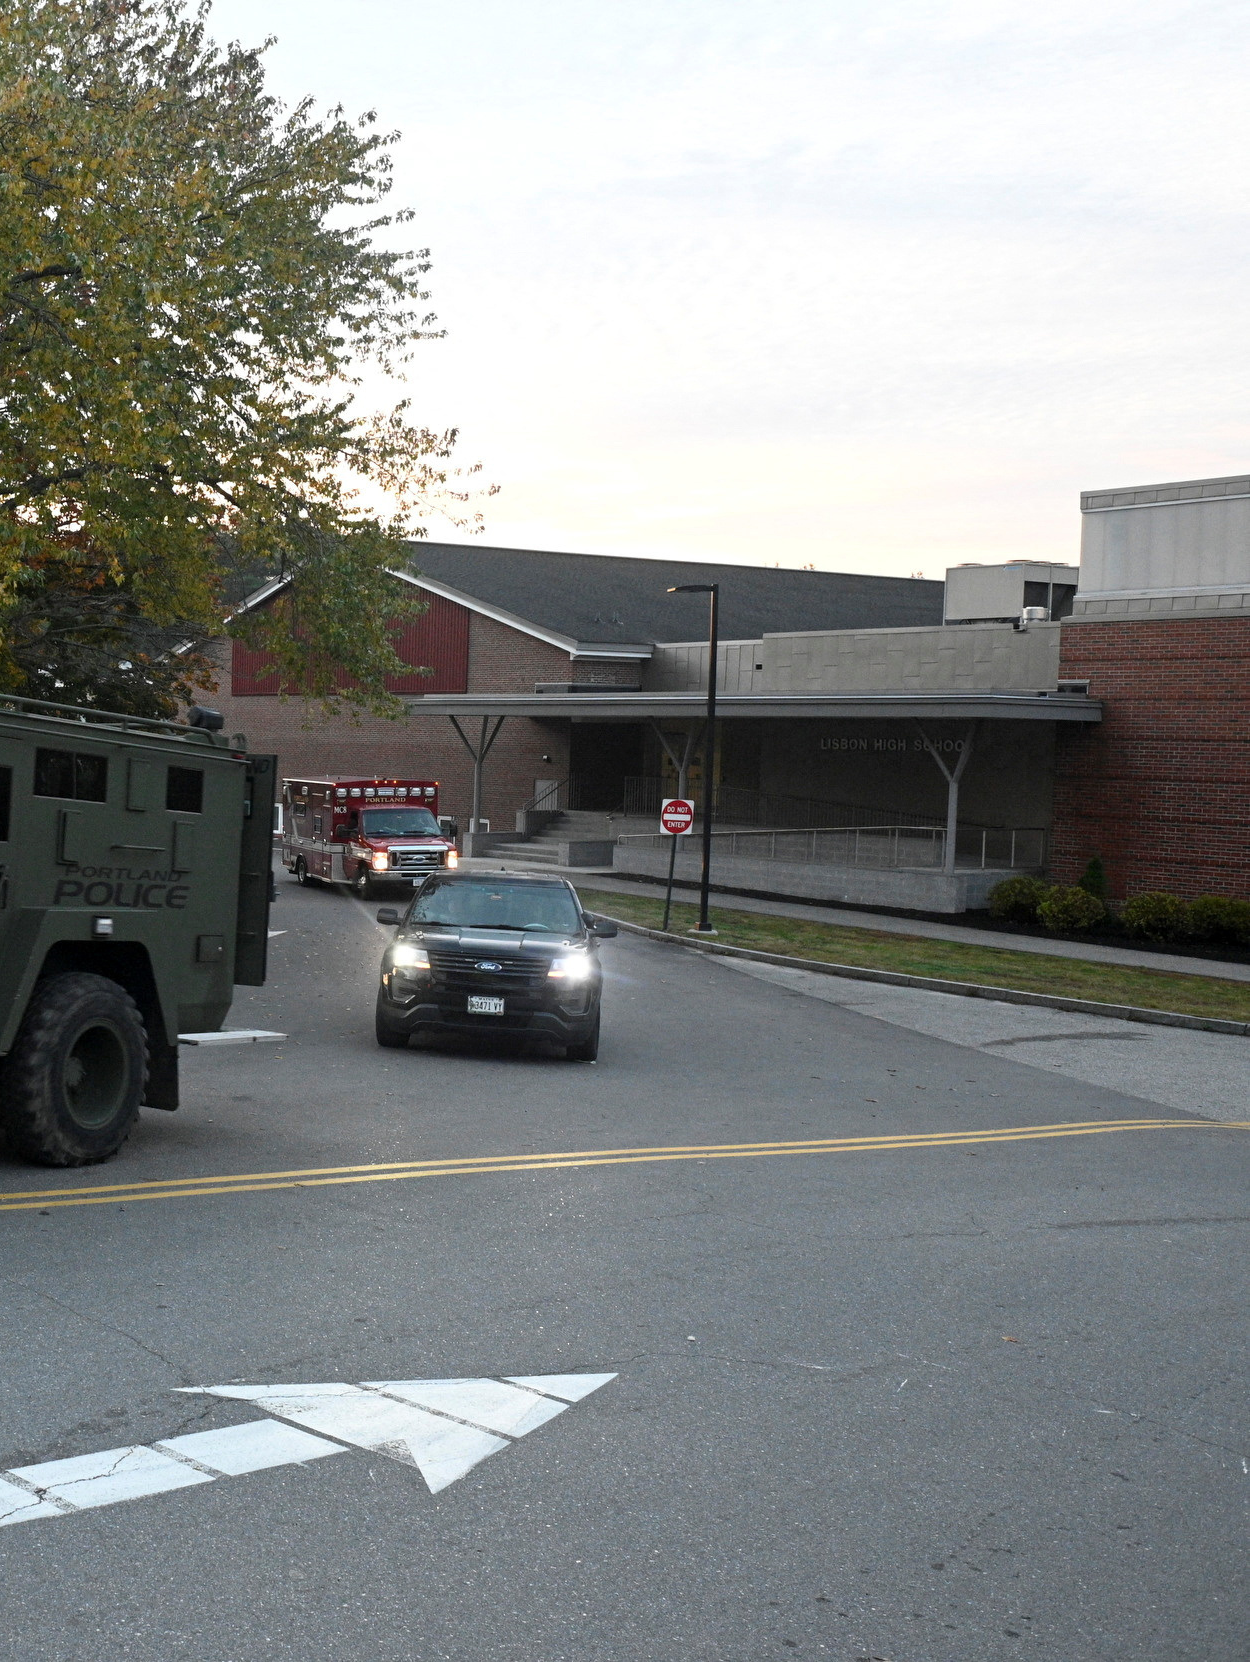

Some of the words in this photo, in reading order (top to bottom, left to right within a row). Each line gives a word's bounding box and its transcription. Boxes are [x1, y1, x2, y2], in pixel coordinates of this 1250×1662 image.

[820, 738, 868, 750] LISBON
[873, 738, 907, 751] HIGH
[913, 739, 971, 752] SCHOO
[65, 865, 183, 882] PORTLAND
[53, 879, 191, 909] POLICE
